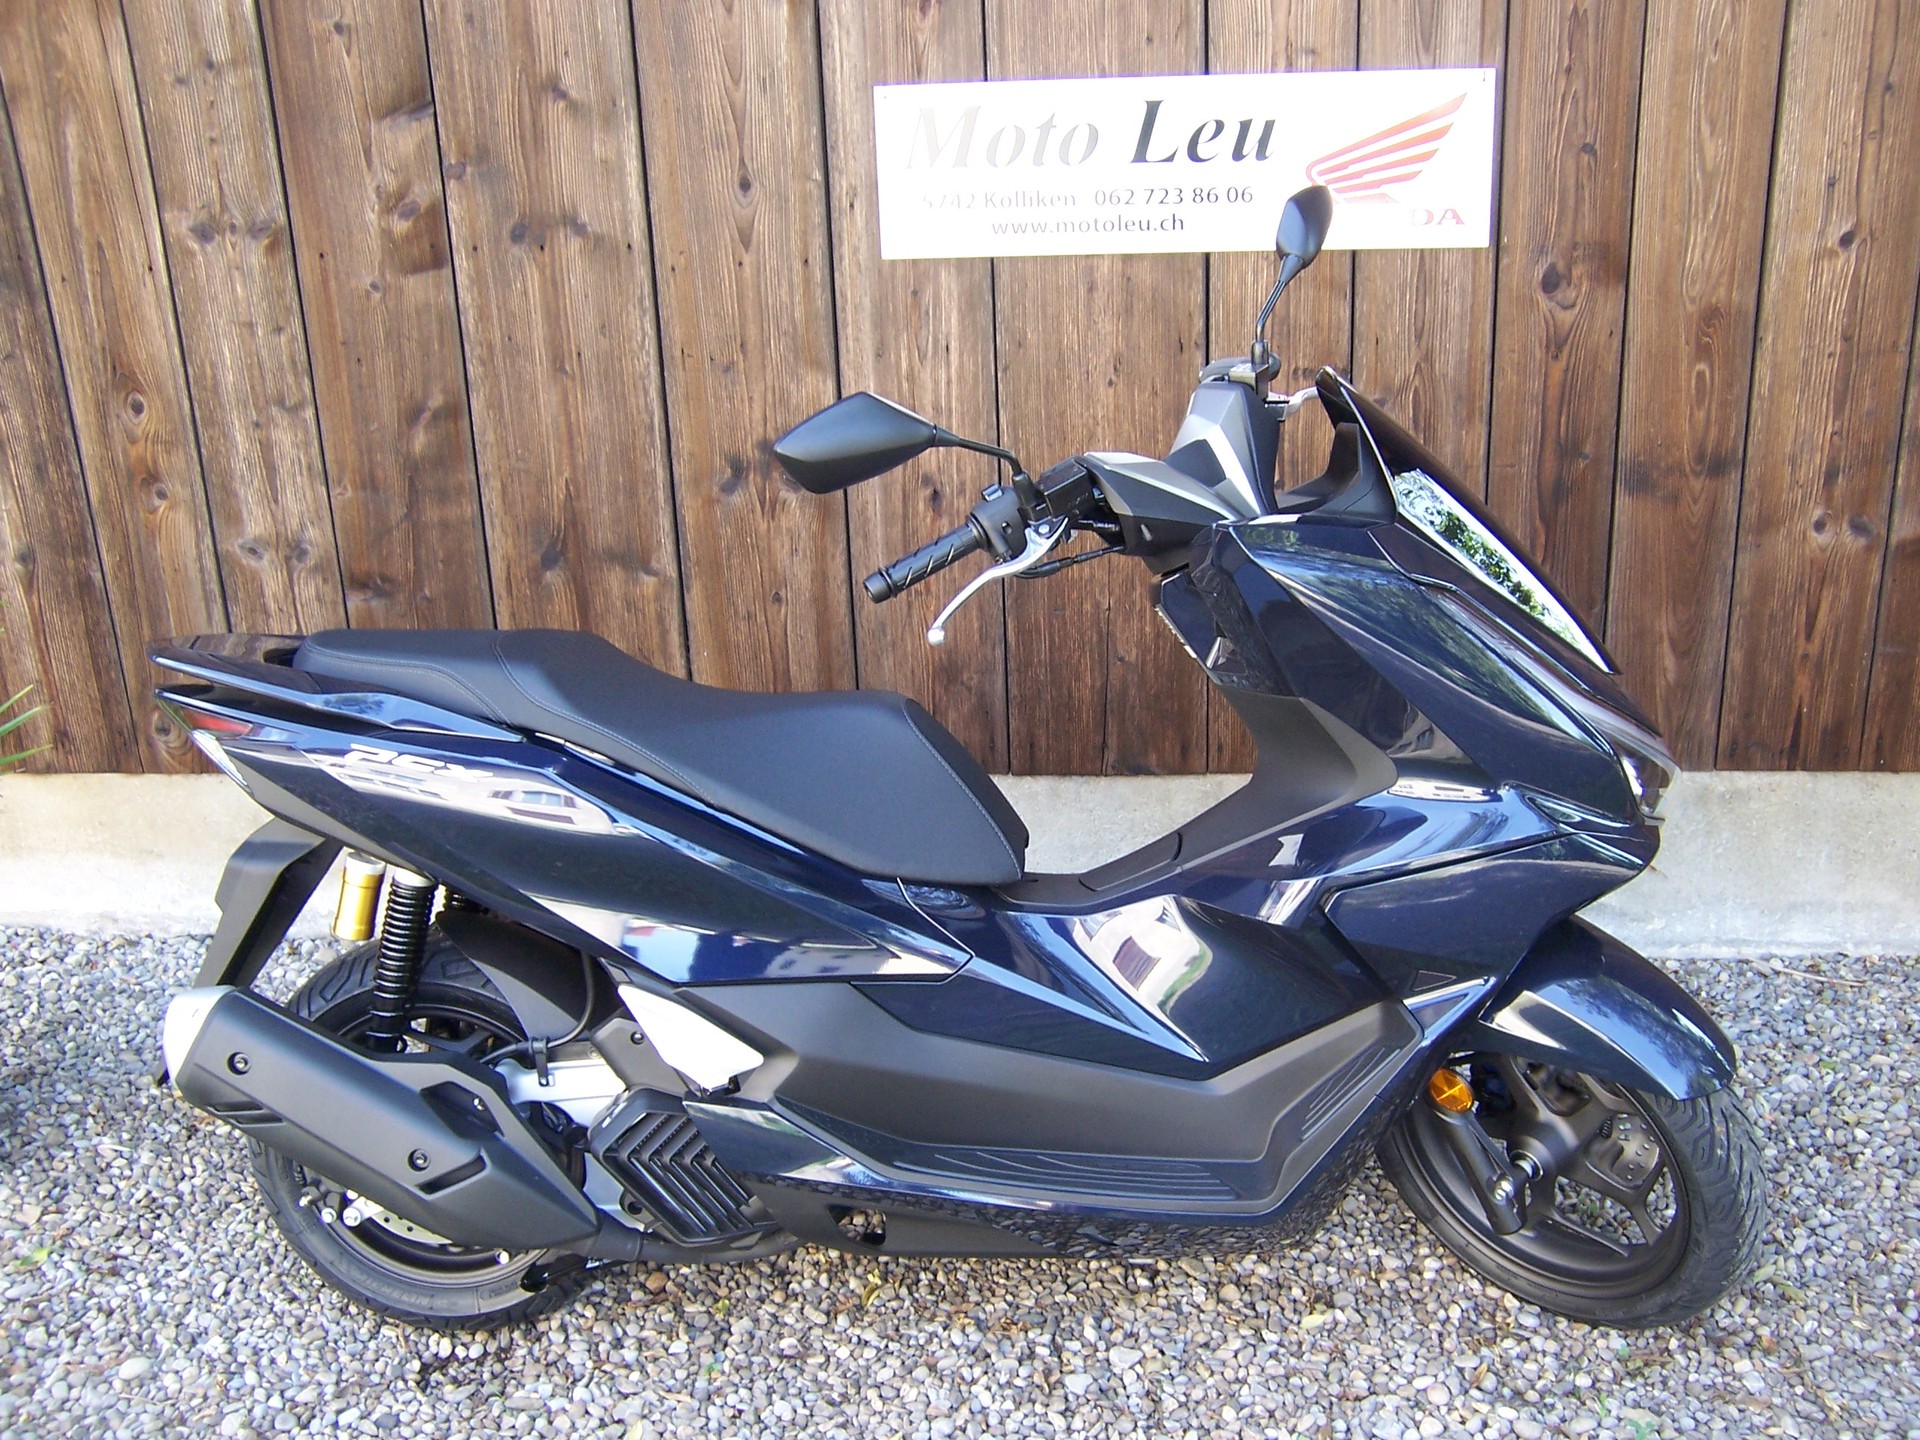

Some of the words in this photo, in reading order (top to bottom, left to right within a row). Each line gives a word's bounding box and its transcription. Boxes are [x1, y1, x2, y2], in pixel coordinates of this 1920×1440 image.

[905, 104, 1099, 169] Moto
[1129, 99, 1276, 163] Leu
[1094, 188, 1136, 206] 062
[1143, 187, 1184, 205] 723
[1192, 186, 1219, 205] 86
[1226, 185, 1254, 204] 06
[991, 212, 1185, 234] www.motoleu.ch
[344, 743, 494, 784] PCX
